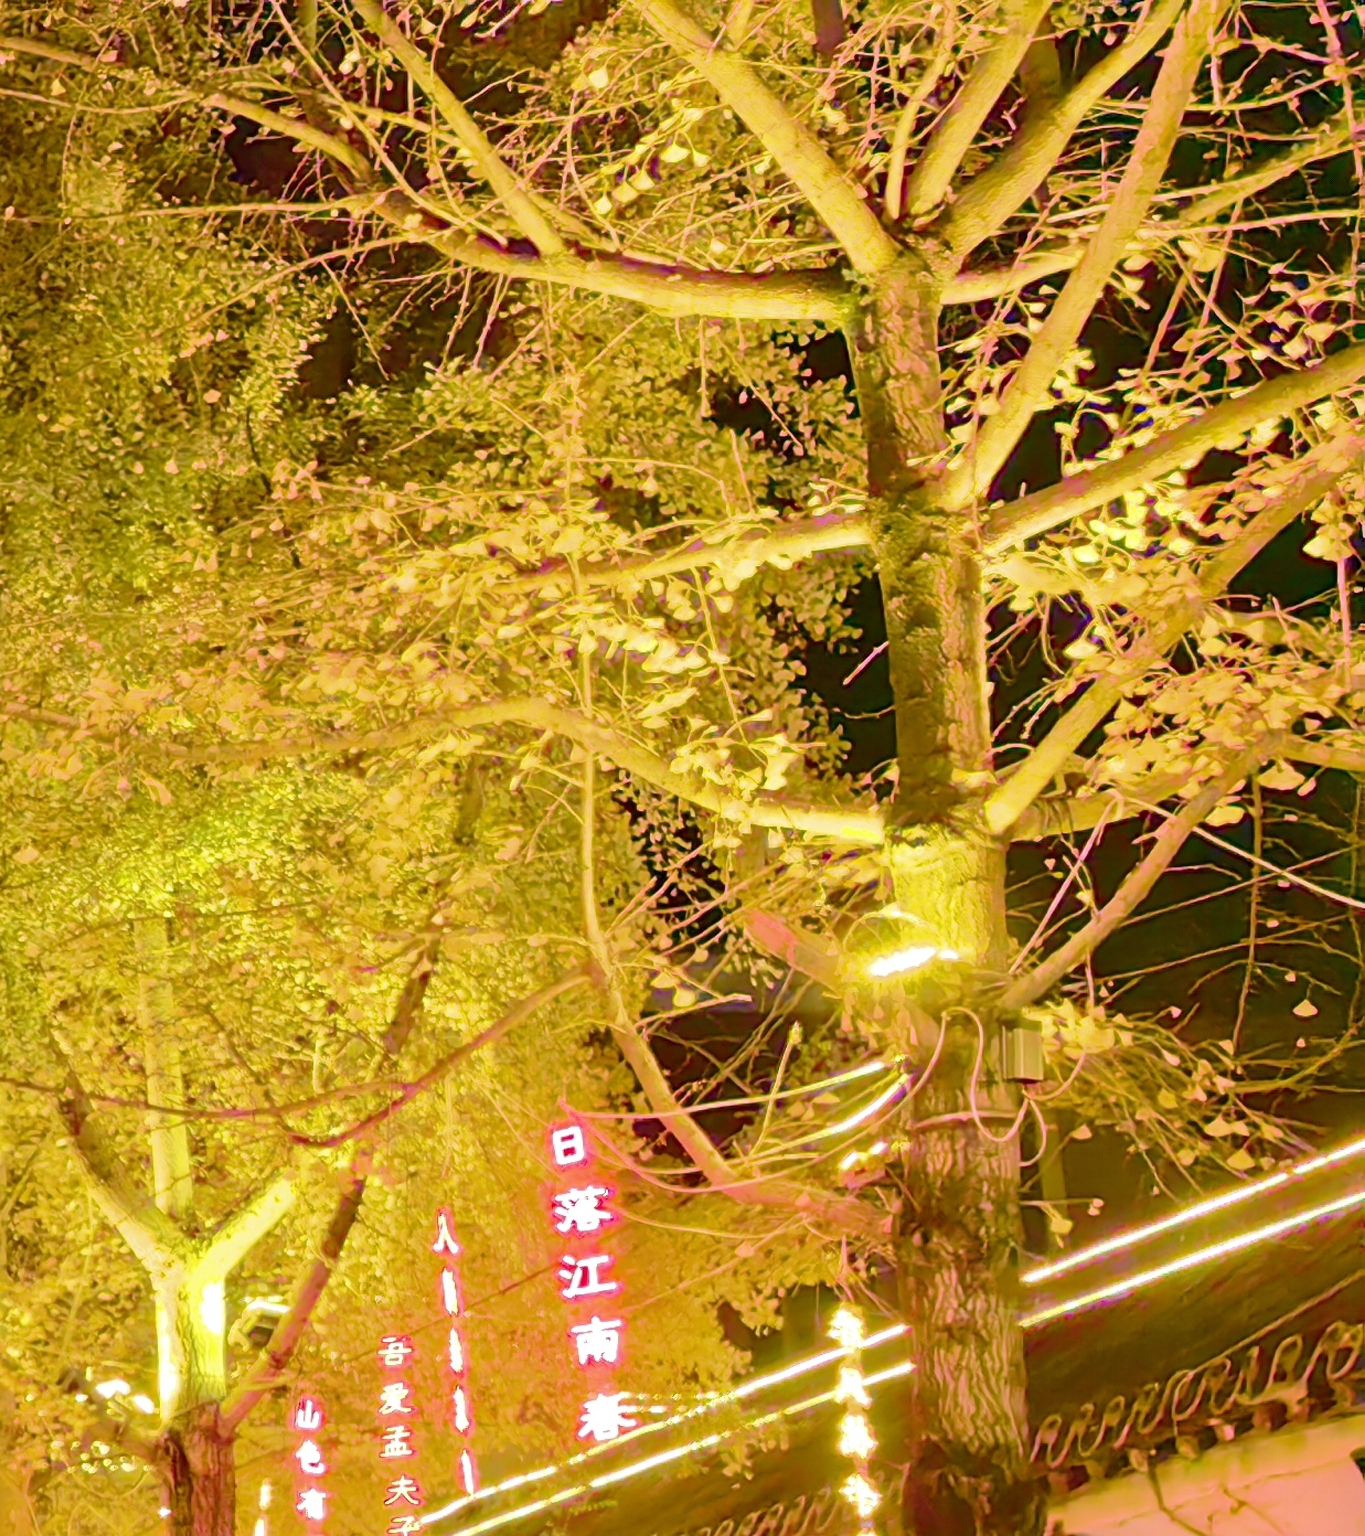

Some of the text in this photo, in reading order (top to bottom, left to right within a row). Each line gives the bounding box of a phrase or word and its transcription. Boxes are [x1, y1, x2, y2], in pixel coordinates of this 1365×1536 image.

[552, 1126, 636, 1442] 日落江南春
